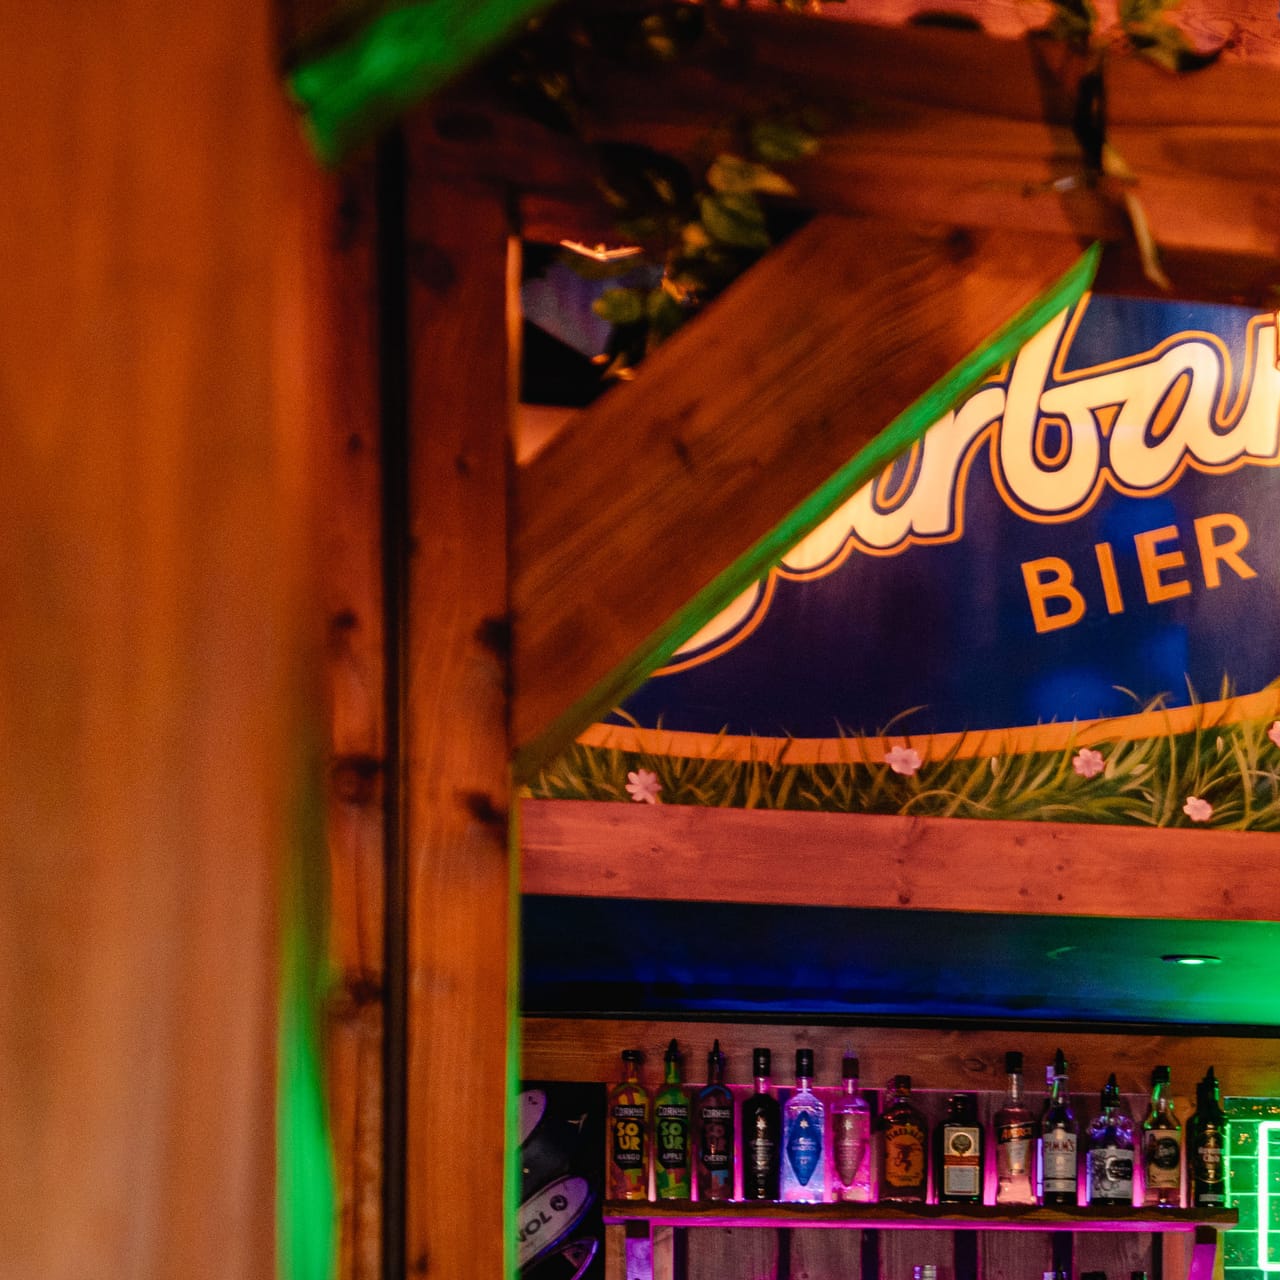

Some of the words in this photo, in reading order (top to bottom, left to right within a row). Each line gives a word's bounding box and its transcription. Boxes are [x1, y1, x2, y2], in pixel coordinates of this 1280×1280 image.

[1020, 513, 1258, 634] BIER
[616, 1122, 638, 1137] SO
[661, 1122, 683, 1137] SO
[618, 1136, 641, 1151] UR
[662, 1136, 684, 1151] UR
